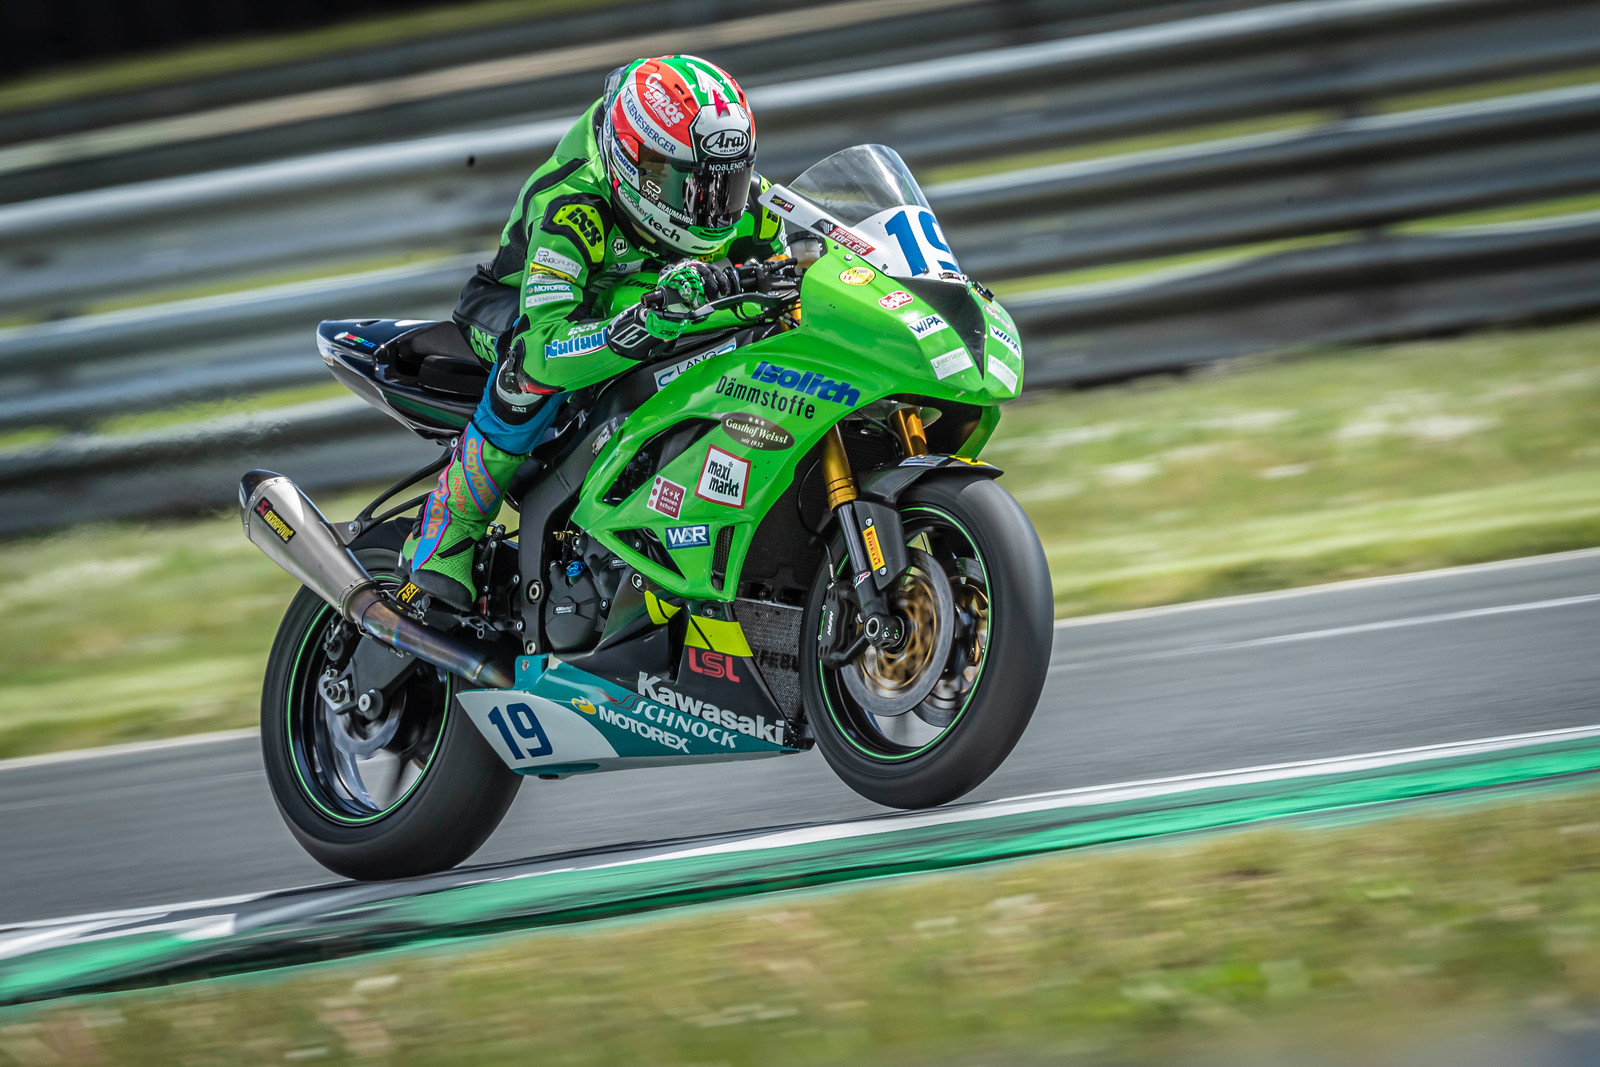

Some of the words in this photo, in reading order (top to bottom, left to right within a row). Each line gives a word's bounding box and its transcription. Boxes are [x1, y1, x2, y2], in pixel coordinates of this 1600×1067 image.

[626, 98, 676, 155] KIENESBERGER
[705, 131, 744, 149] Arai
[641, 185, 659, 201] LANG
[657, 201, 694, 225] BRAUMANDL
[829, 231, 867, 255] KOFLER
[534, 285, 571, 293] MOTOREX
[908, 316, 944, 334] WIPA
[990, 326, 1021, 356] WIPA
[715, 375, 815, 420] Dämmstoffe
[751, 361, 861, 407] Isolith
[725, 418, 759, 438] Gasthof
[758, 428, 789, 445] Weissl
[707, 460, 735, 482] maxi
[709, 477, 740, 498] markt
[659, 502, 677, 513] schutz
[865, 530, 882, 567] PIRELLI
[688, 647, 740, 683] LSL
[638, 671, 784, 746] Kawasaki
[487, 702, 554, 760] 19
[598, 705, 690, 753] MOTOREX
